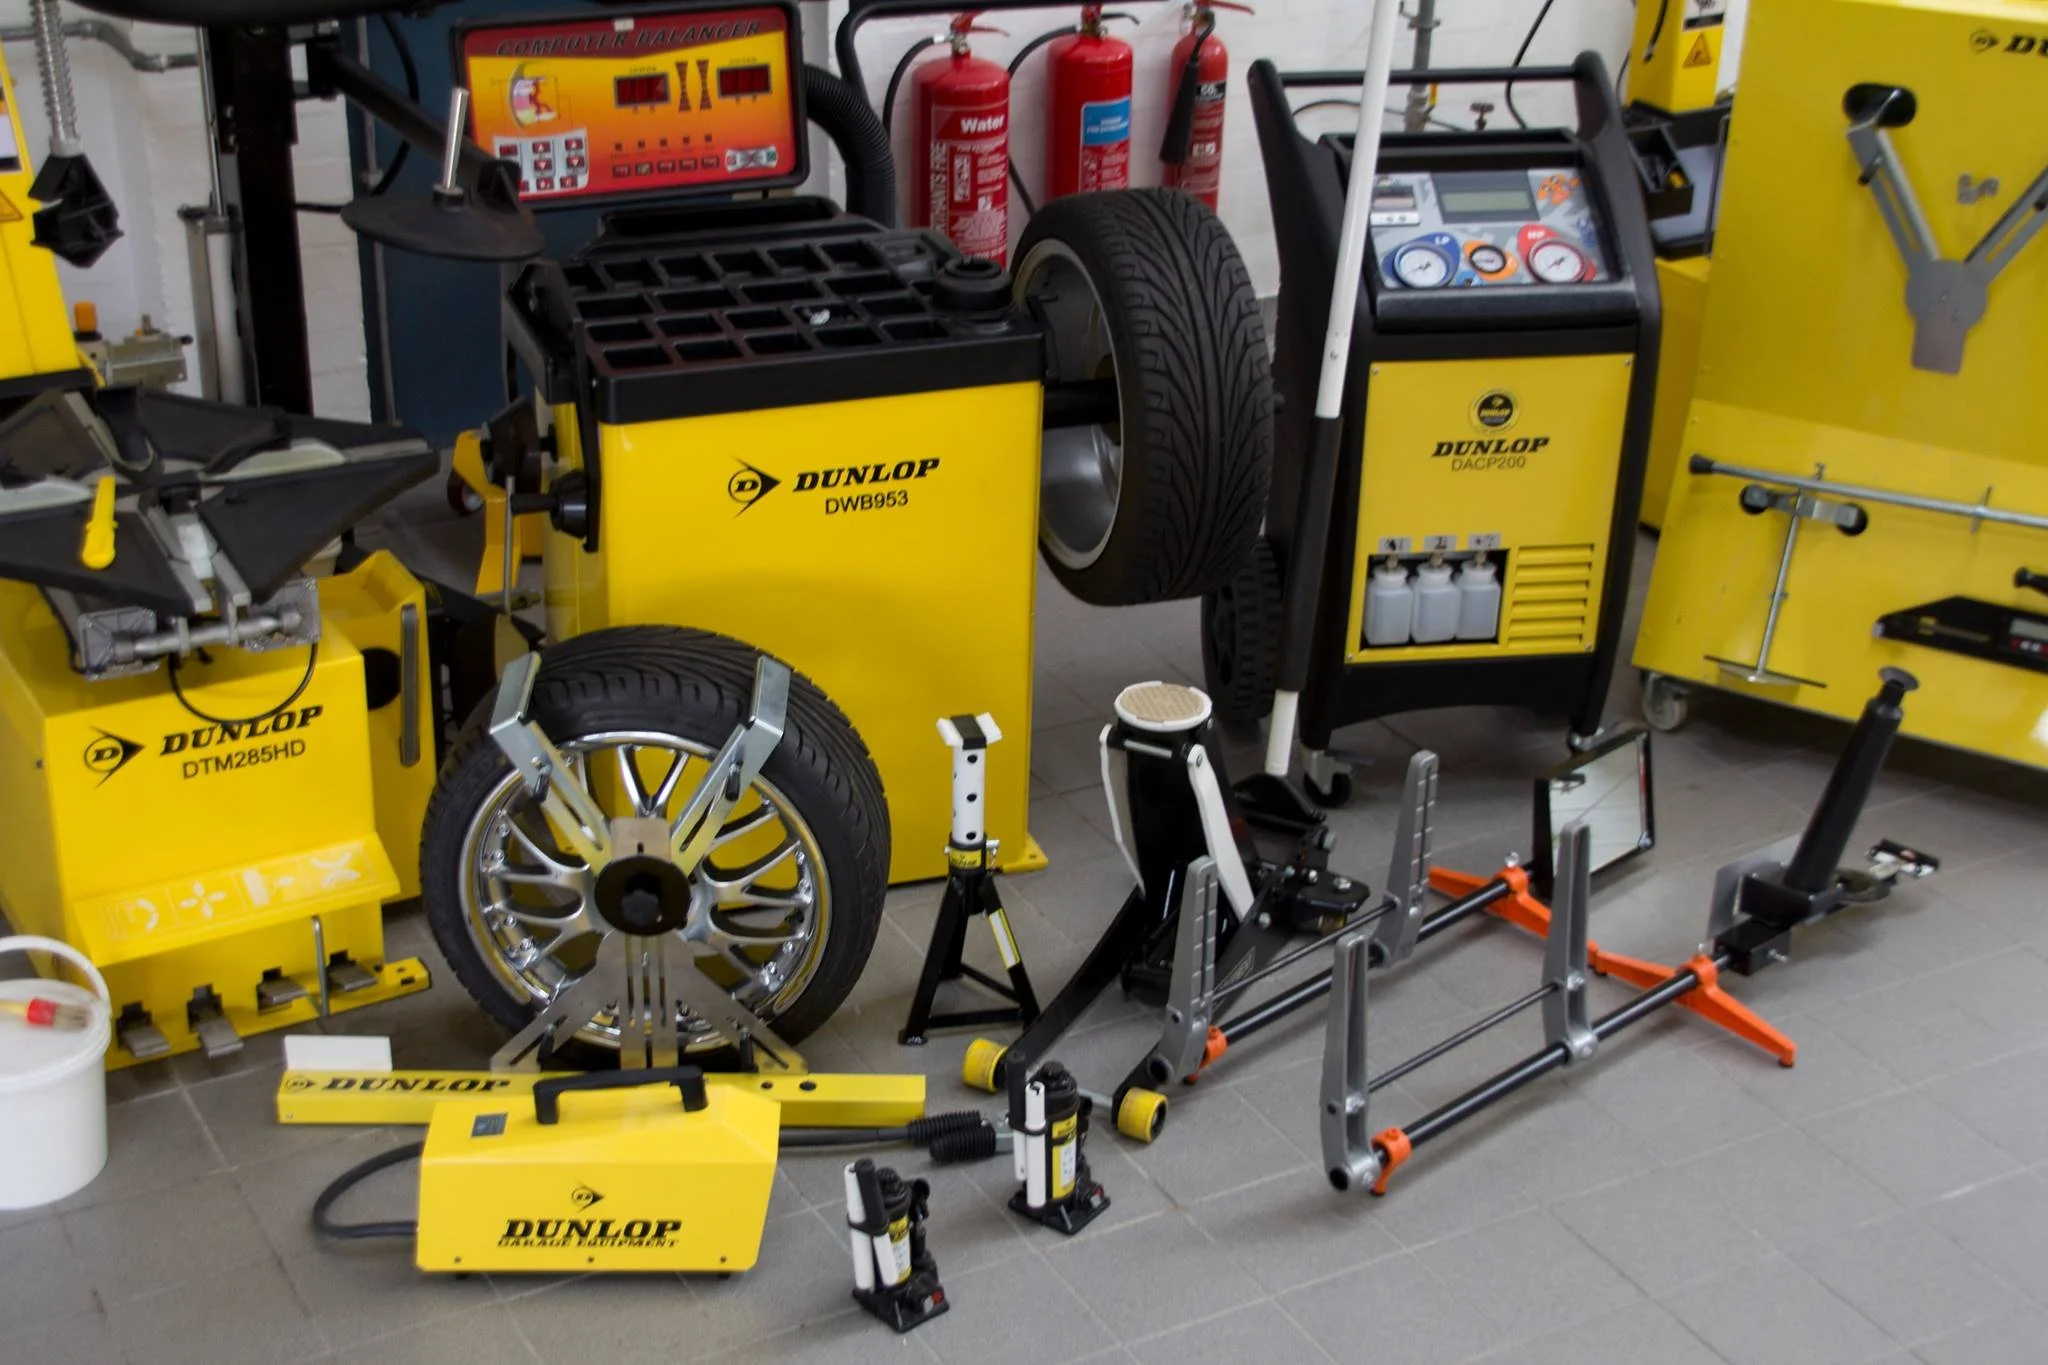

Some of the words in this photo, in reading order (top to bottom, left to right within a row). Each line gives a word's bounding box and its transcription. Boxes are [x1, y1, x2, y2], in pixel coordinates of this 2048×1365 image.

[497, 31, 628, 56] COMPUTER
[635, 22, 760, 48] BALANCER
[960, 115, 1005, 134] Water
[1431, 437, 1550, 457] DUNLOP
[1450, 456, 1526, 472] DACP200
[793, 458, 940, 493] DUNLOP
[825, 489, 908, 515] DWB953
[159, 705, 323, 756] DUNLOP
[182, 739, 306, 780] DTM285HD
[321, 1077, 512, 1092] DUNLOP
[502, 1219, 683, 1238] DUNLOP
[497, 1235, 572, 1248] GARAGE
[576, 1235, 680, 1248] EQUIPMENT
